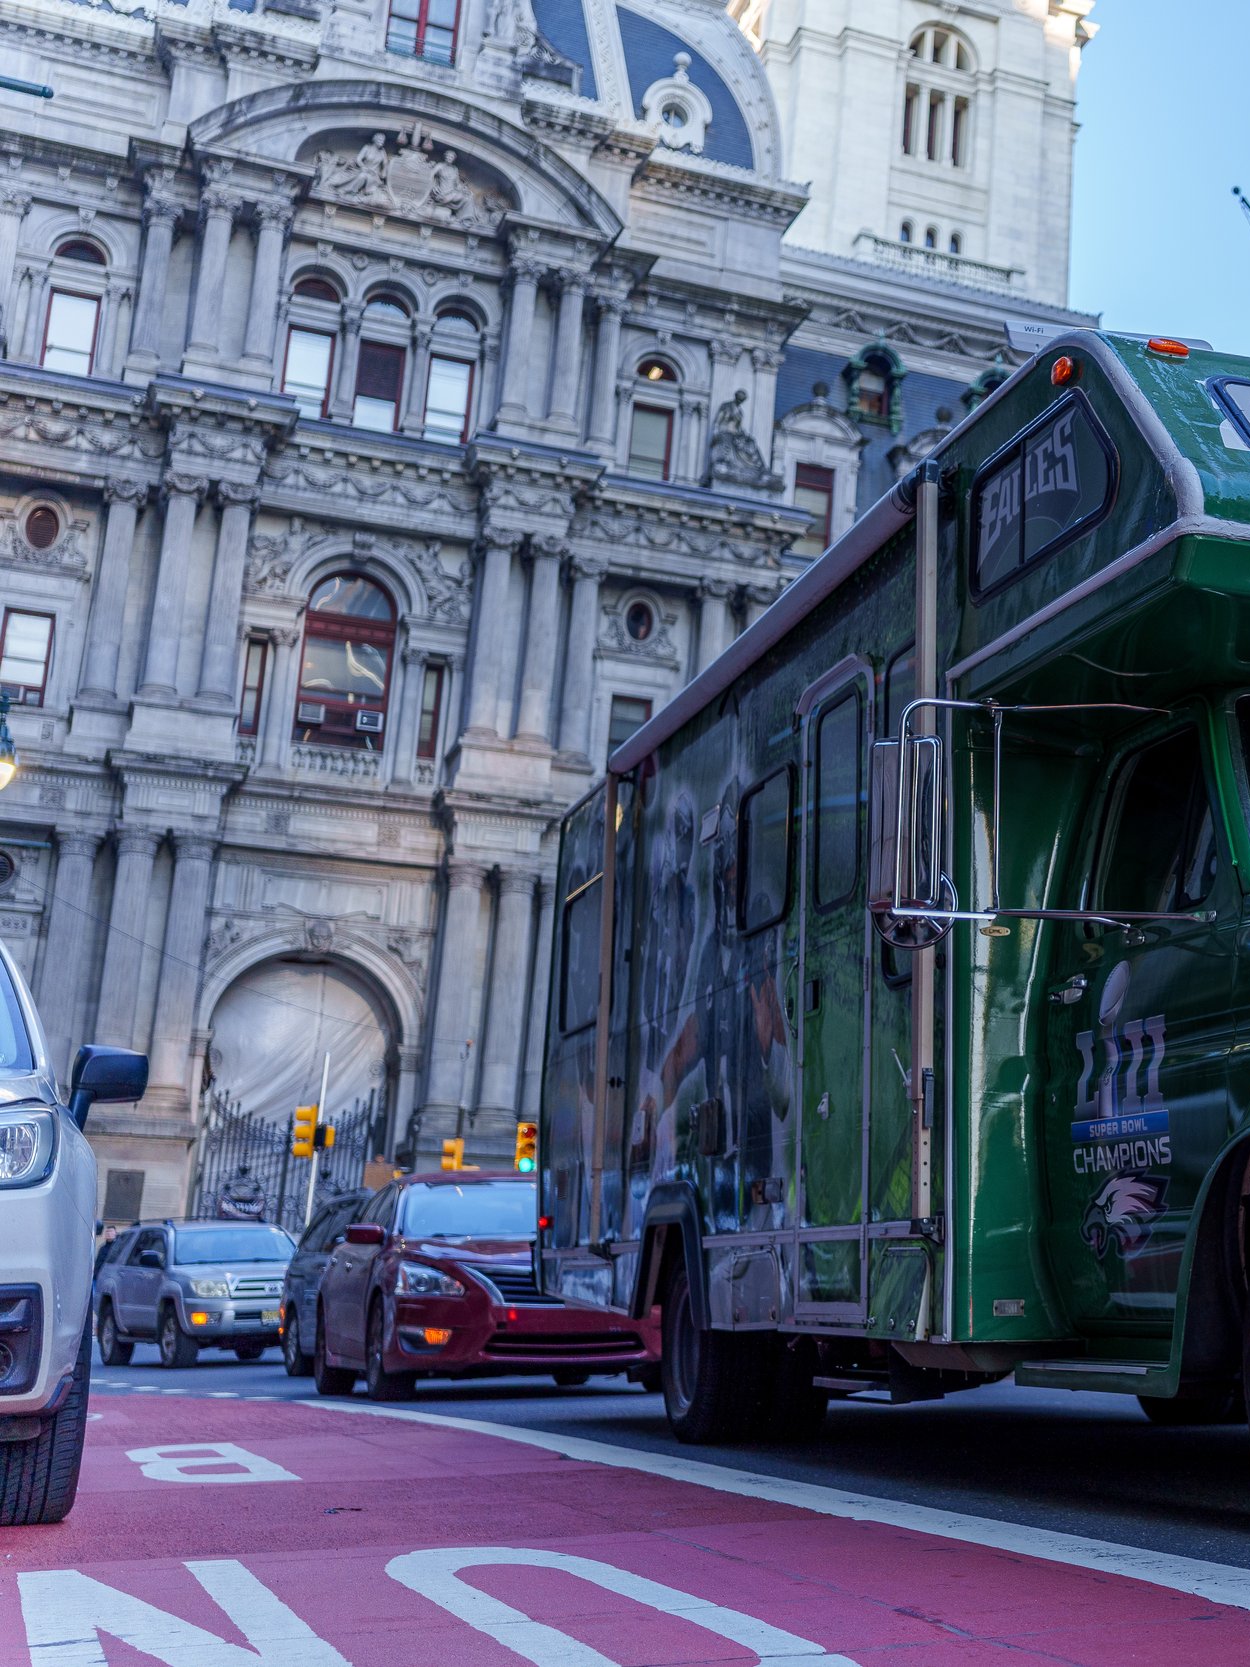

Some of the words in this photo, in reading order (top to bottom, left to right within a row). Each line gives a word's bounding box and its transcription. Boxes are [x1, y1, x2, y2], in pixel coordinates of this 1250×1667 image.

[1024, 326, 1044, 334] Wi-Fi
[1089, 1120, 1119, 1138] SUPER
[1121, 1117, 1149, 1134] BOWL
[1073, 1136, 1172, 1174] CHAMPIONS
